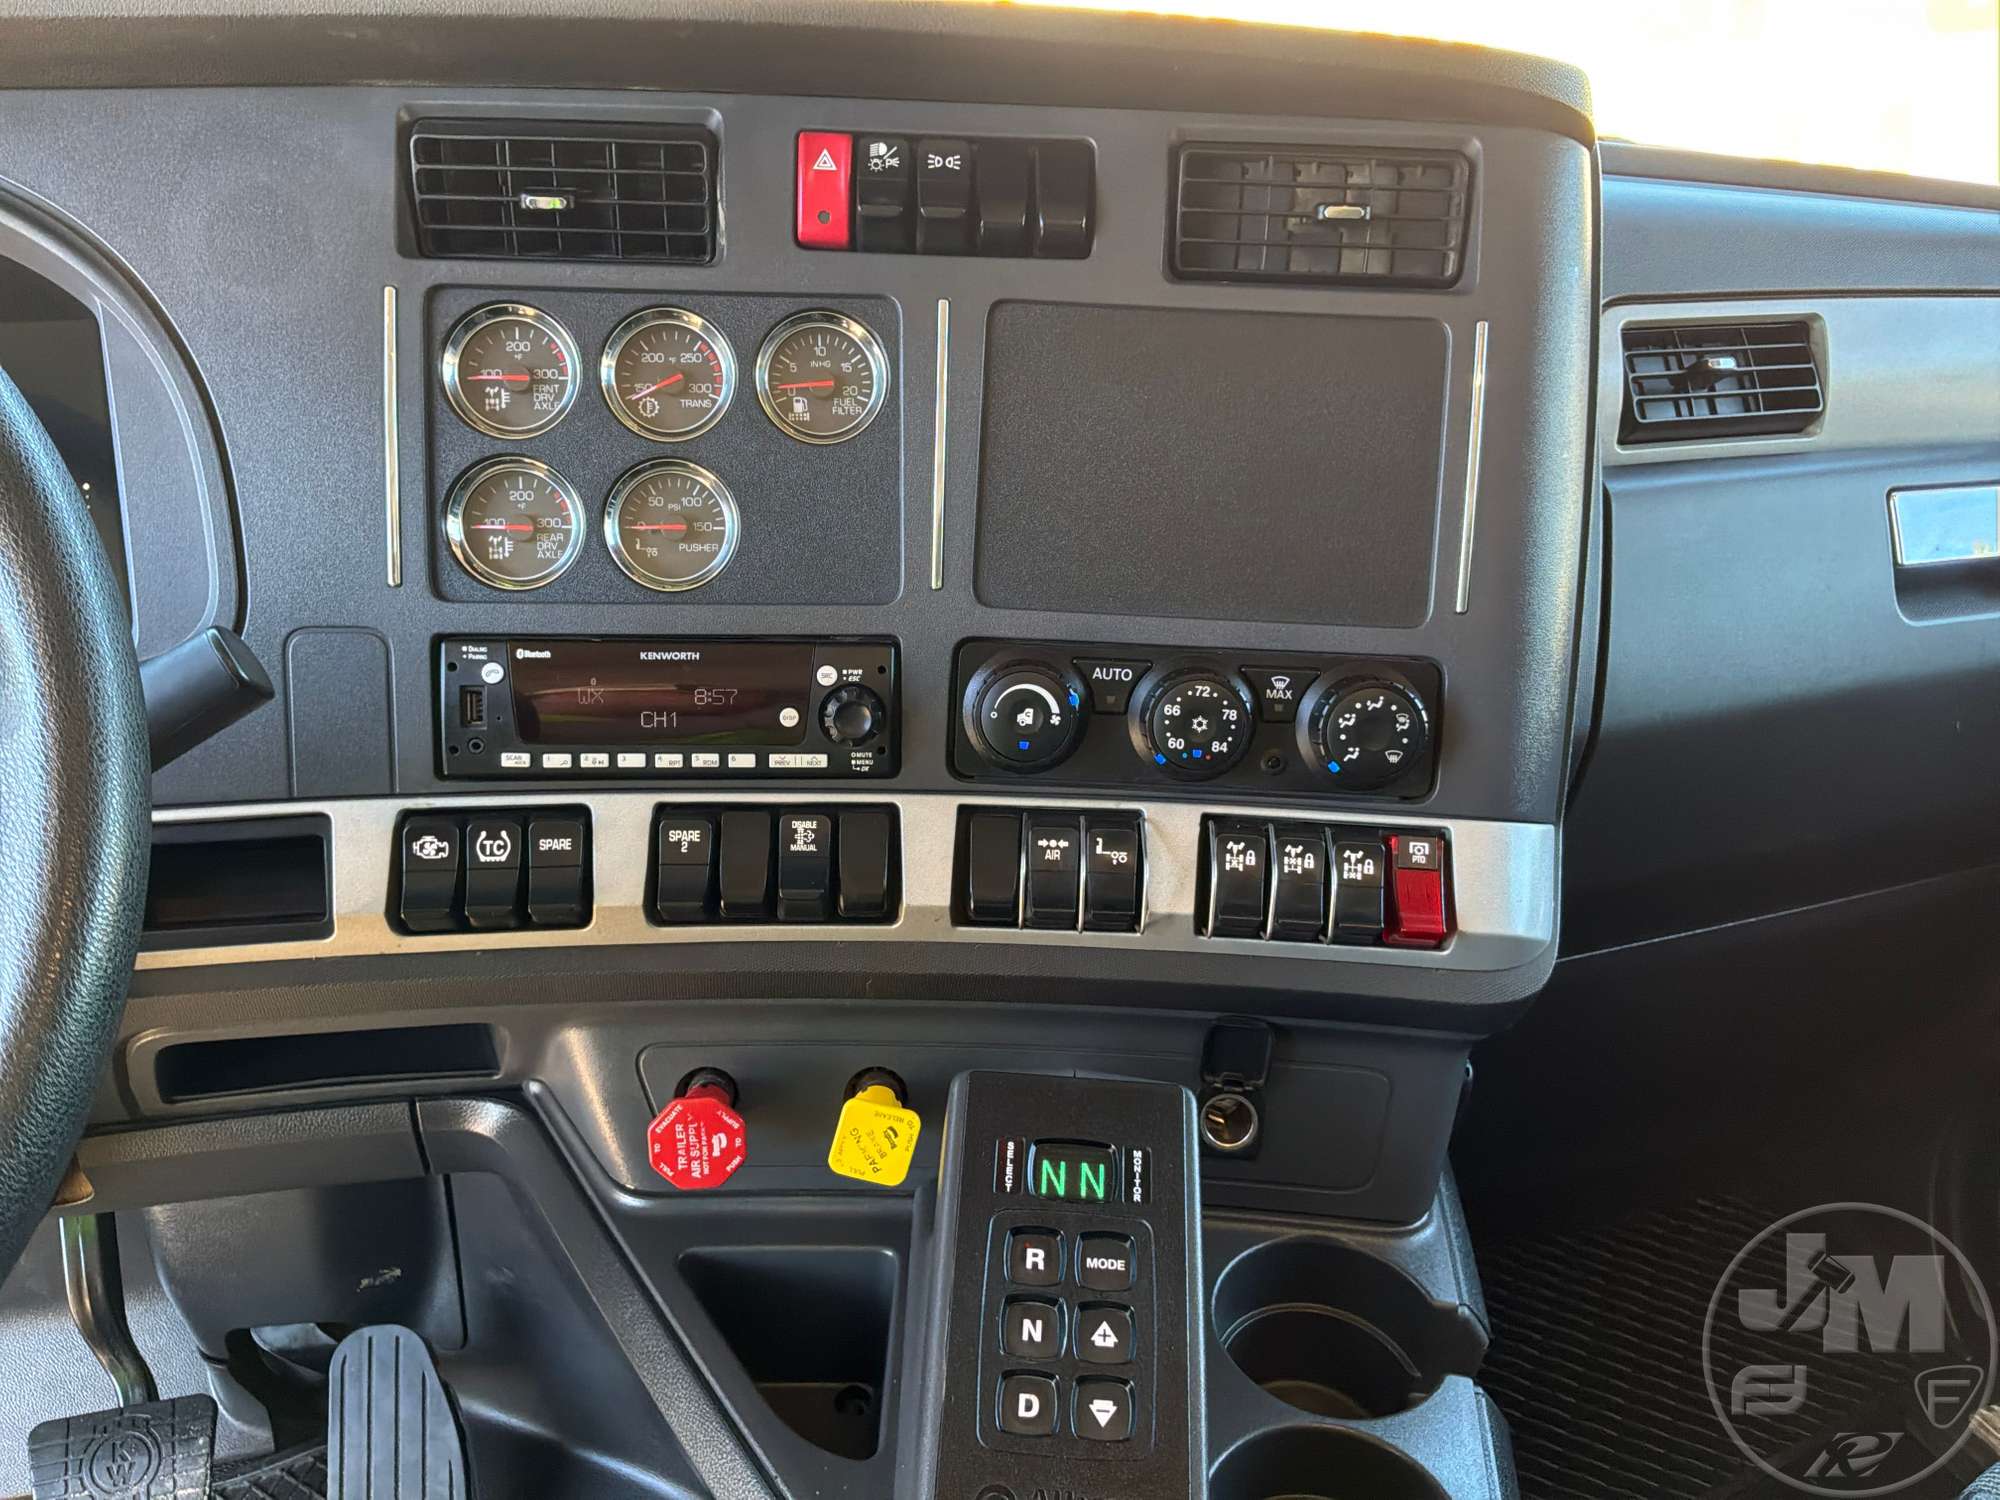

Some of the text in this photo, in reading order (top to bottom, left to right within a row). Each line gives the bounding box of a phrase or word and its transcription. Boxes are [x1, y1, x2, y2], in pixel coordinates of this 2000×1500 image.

[505, 341, 531, 352] 200
[814, 346, 826, 357] 10
[641, 353, 664, 363] 200
[680, 353, 702, 363] 250
[790, 362, 797, 372] 5
[841, 362, 852, 373] 15
[533, 369, 558, 379] 300
[533, 384, 560, 393] FRNT
[688, 383, 712, 393] 300
[842, 386, 858, 396] 20
[533, 393, 554, 402] DRV
[834, 398, 857, 407] FUEL
[534, 401, 560, 410] AXLE
[680, 399, 712, 409] TRANS
[832, 406, 862, 415] FILTER
[509, 491, 535, 501] 200
[648, 497, 664, 507] 50
[681, 497, 702, 507] 100
[537, 518, 561, 528] 300
[693, 522, 713, 532] 150
[537, 533, 563, 542] REAR
[537, 542, 558, 550] DRV
[679, 544, 719, 553] PUSHER
[537, 550, 563, 559] AXLE
[640, 651, 700, 661] KENWORTH
[1092, 668, 1132, 681] AUTO
[577, 688, 604, 705] WX
[694, 688, 738, 705] 8:57
[1195, 686, 1210, 697] 72
[1265, 688, 1293, 700] MAX
[1164, 704, 1181, 716] 66
[1222, 709, 1237, 720] 78
[640, 711, 677, 728] CH1
[1167, 738, 1185, 750] 60
[1211, 741, 1228, 753] 84
[791, 820, 817, 829] DISABLE
[668, 830, 701, 842] SPARE
[482, 840, 505, 855] TC
[539, 838, 572, 851] SPARE
[681, 841, 688, 852] 2
[790, 843, 818, 851] MANUAL
[1044, 849, 1061, 861] AIR
[1411, 855, 1427, 864] PTO
[654, 1143, 661, 1153] TO
[675, 1123, 688, 1171] TRAILER
[687, 1113, 702, 1178] AIR SUPPLY
[735, 1137, 742, 1148] TO
[1005, 1141, 1015, 1193] SELECT
[1040, 1159, 1105, 1199] N N
[1133, 1150, 1142, 1202] MONITOR
[1025, 1248, 1045, 1270] R
[1086, 1258, 1126, 1271] MODE
[1022, 1318, 1042, 1342] N
[1017, 1393, 1040, 1417] D
